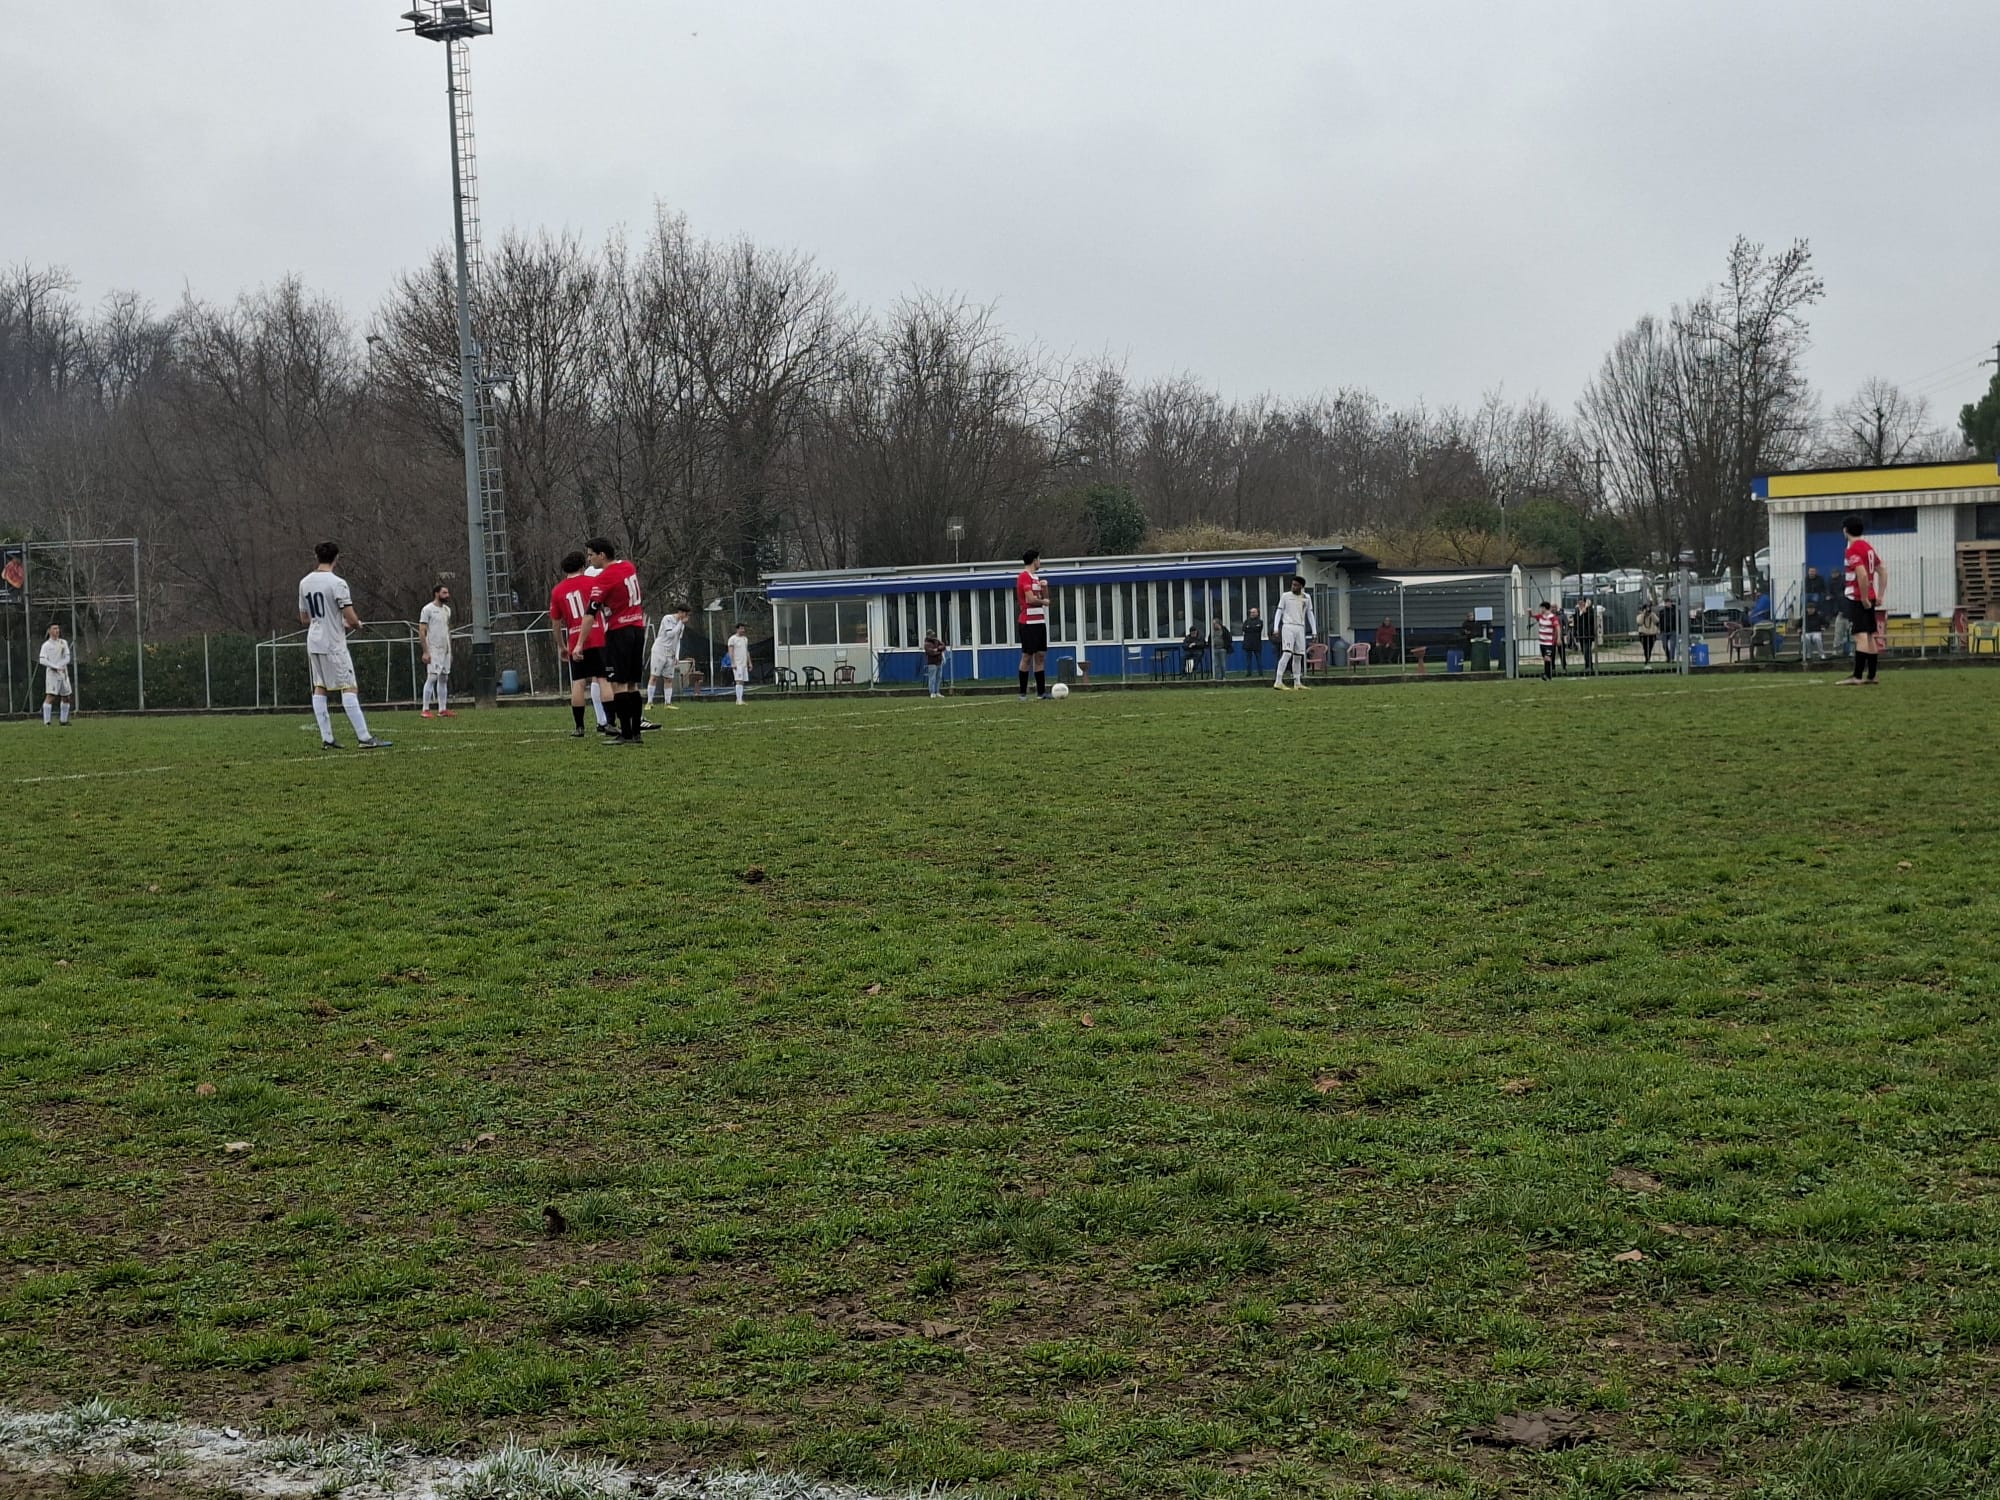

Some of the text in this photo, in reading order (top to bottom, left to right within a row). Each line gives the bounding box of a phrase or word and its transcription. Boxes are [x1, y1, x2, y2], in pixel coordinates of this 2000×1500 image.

[305, 591, 325, 618] 10
[566, 590, 585, 619] 11
[624, 574, 641, 607] 10
